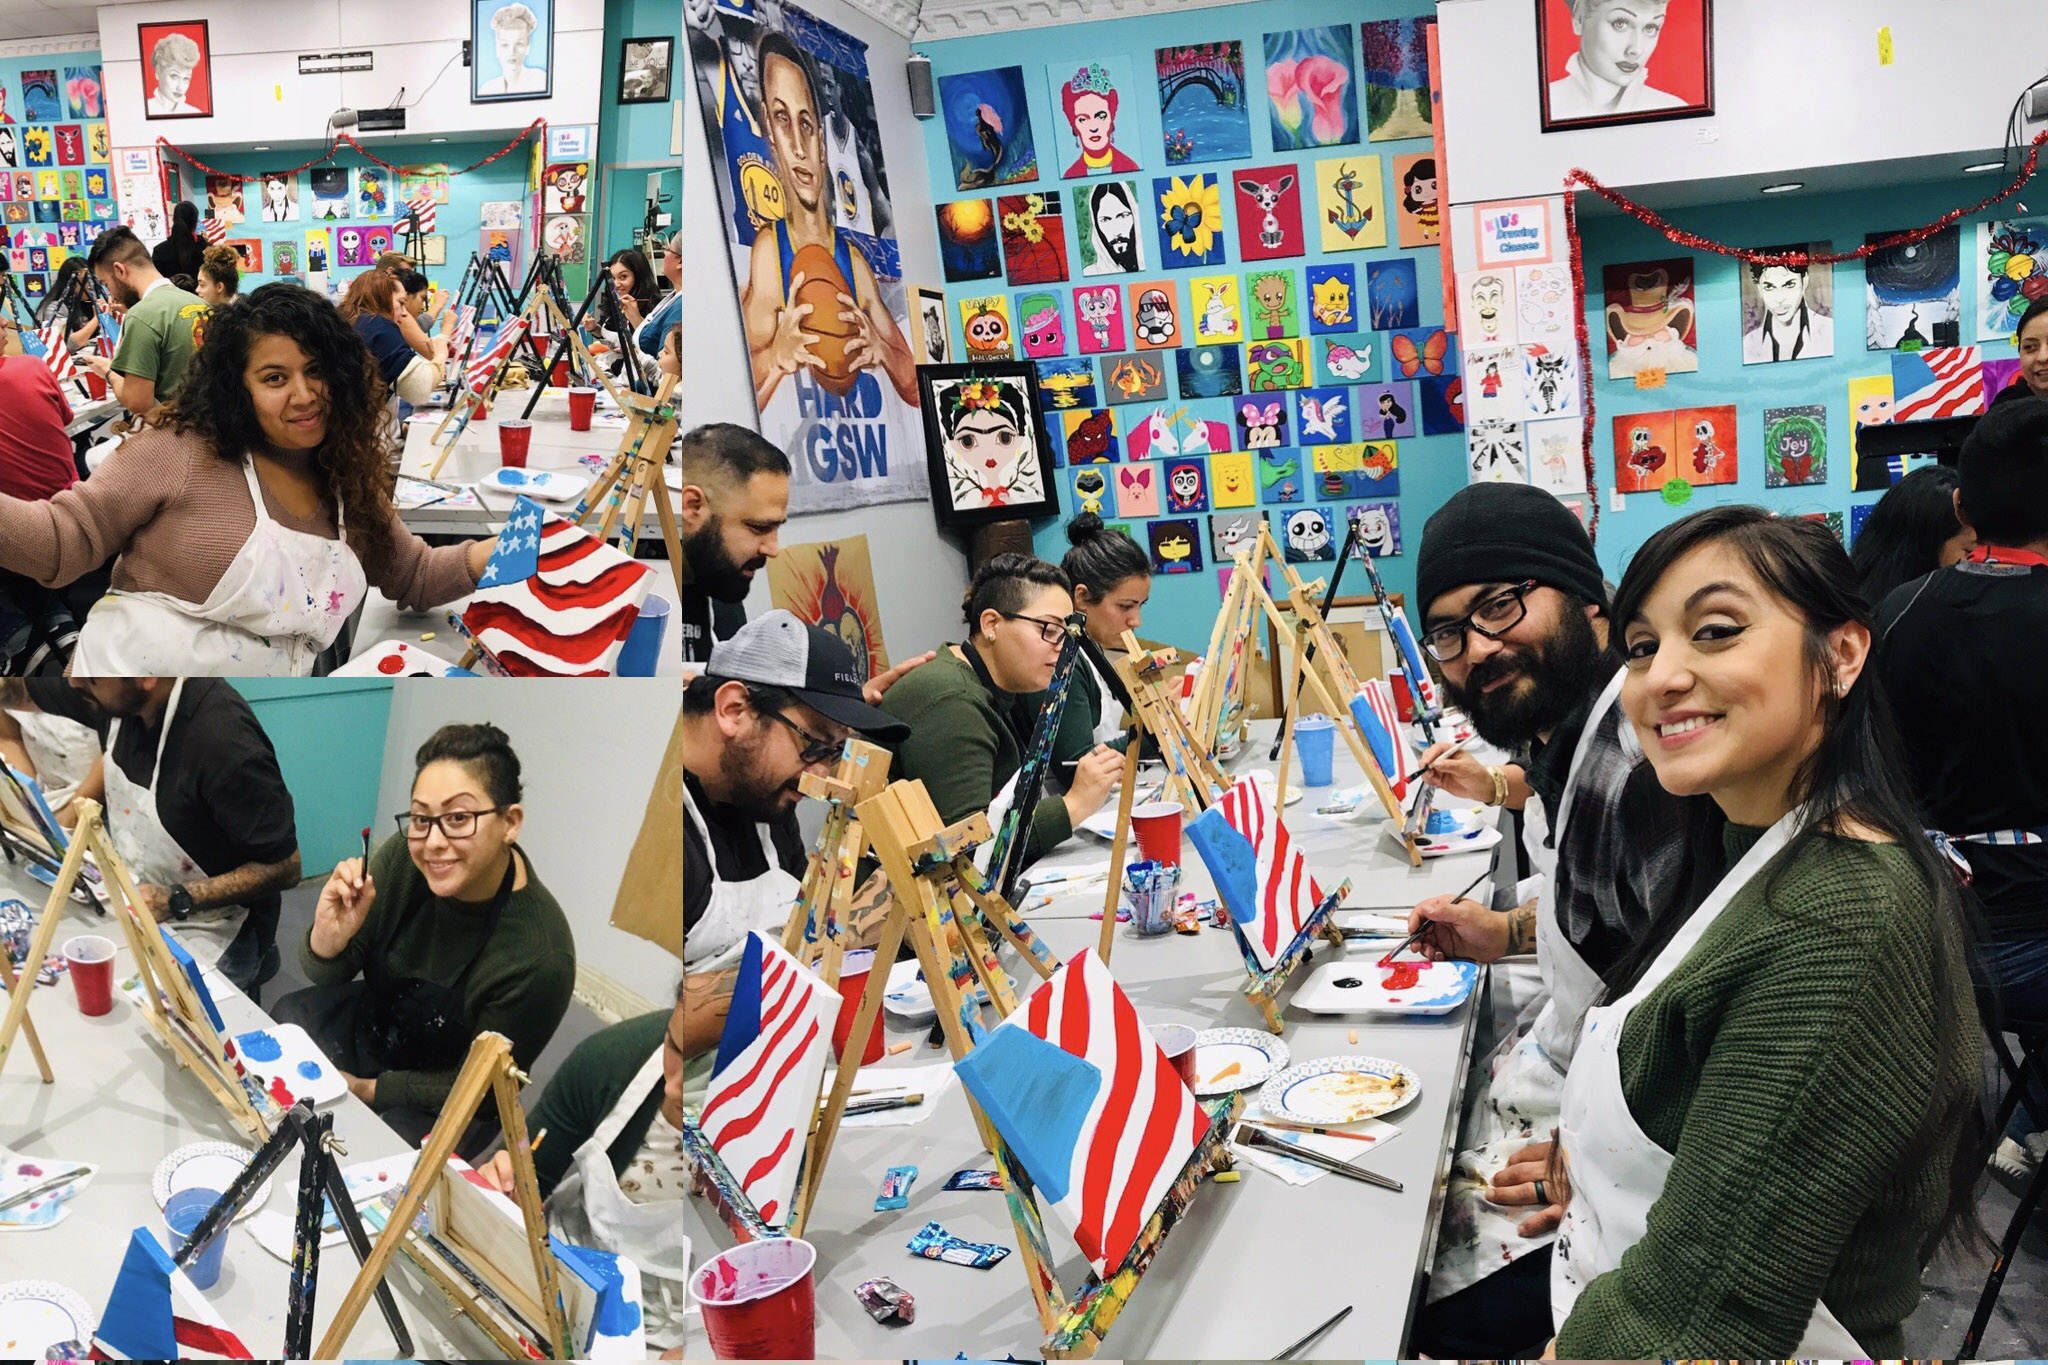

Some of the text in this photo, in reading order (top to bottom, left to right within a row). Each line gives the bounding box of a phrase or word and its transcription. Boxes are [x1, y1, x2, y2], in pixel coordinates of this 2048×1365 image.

[643, 56, 667, 67] VOIC
[763, 184, 779, 203] 40
[972, 353, 1010, 361] HALLOWEEN
[806, 423, 888, 483] GSW
[1780, 436, 1808, 457] Joy
